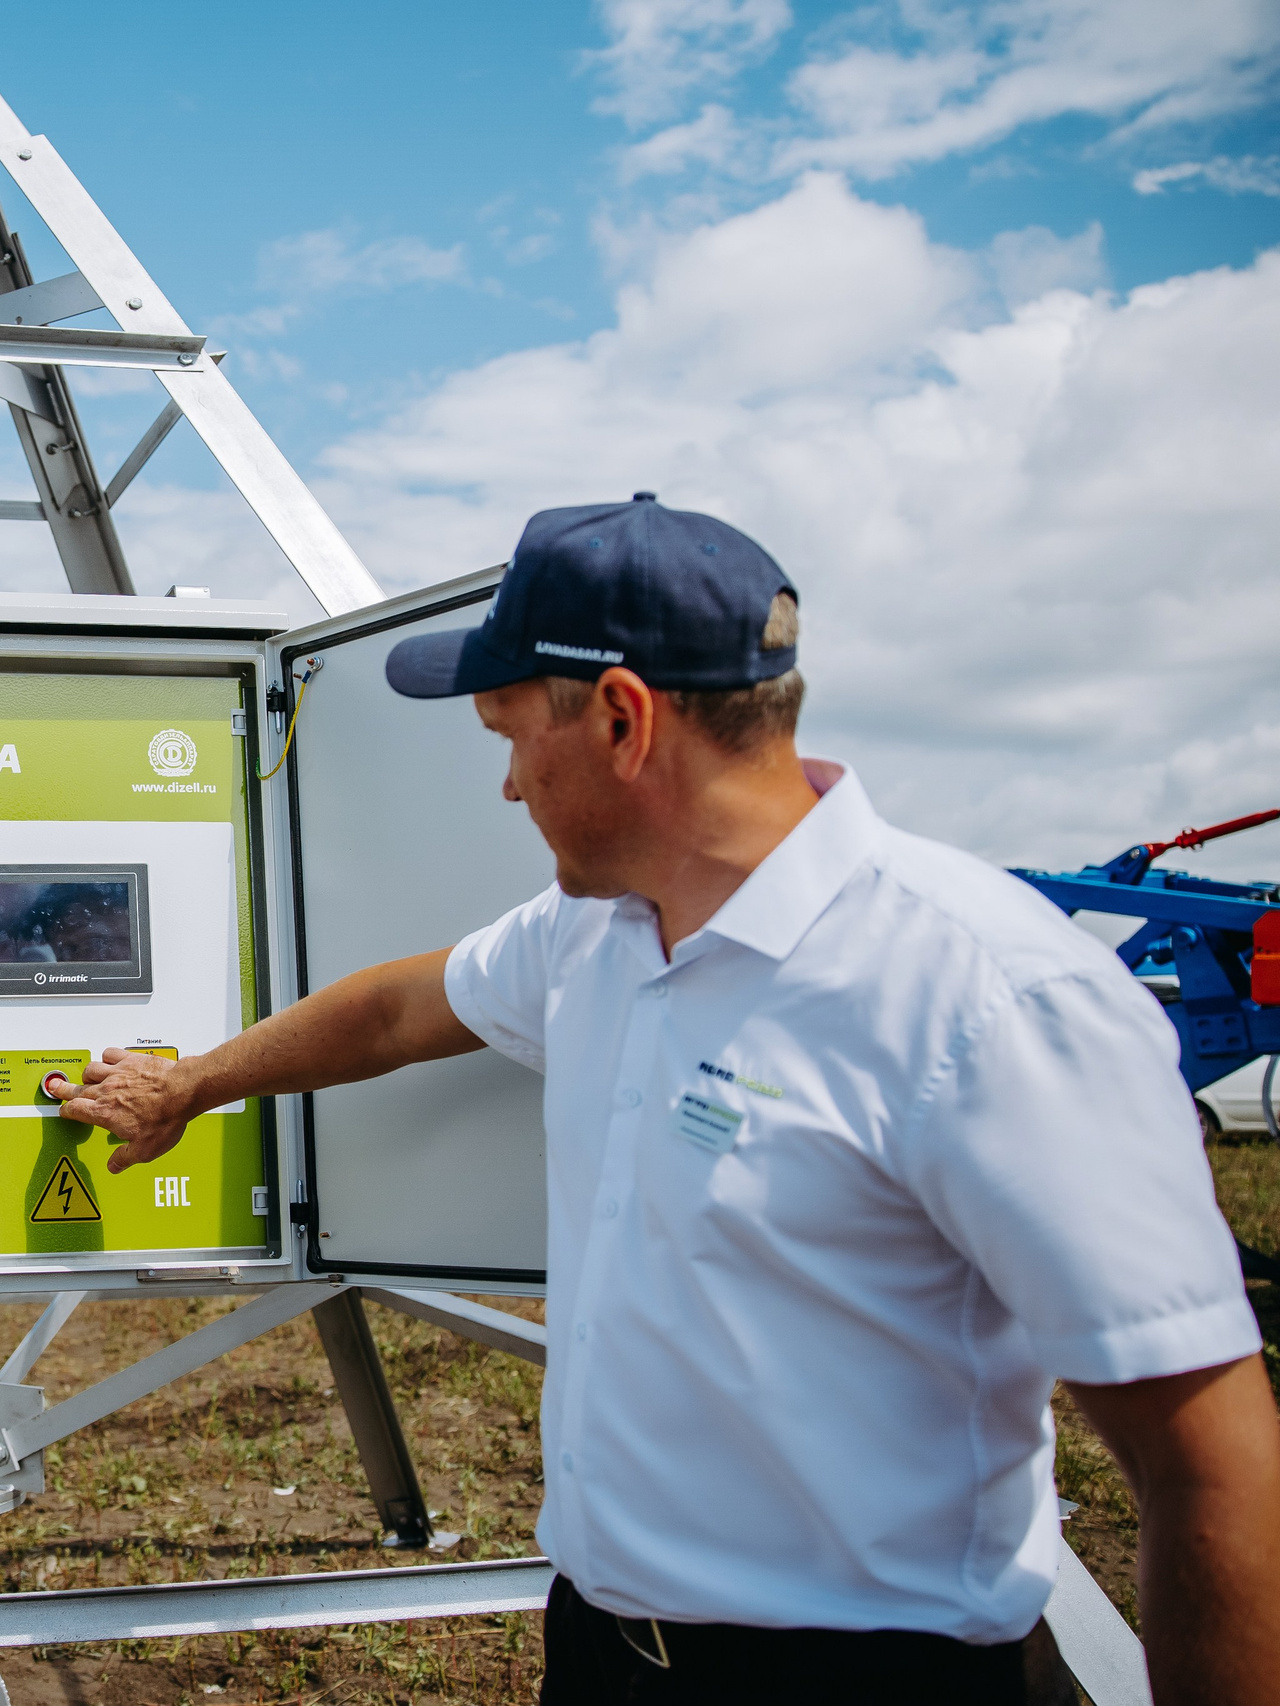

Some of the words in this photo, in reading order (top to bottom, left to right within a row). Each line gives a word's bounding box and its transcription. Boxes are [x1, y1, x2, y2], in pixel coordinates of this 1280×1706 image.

[131, 782, 216, 793] www.dizell.ru
[48, 974, 88, 983] irrimatic
[154, 1176, 191, 1207] EAC
